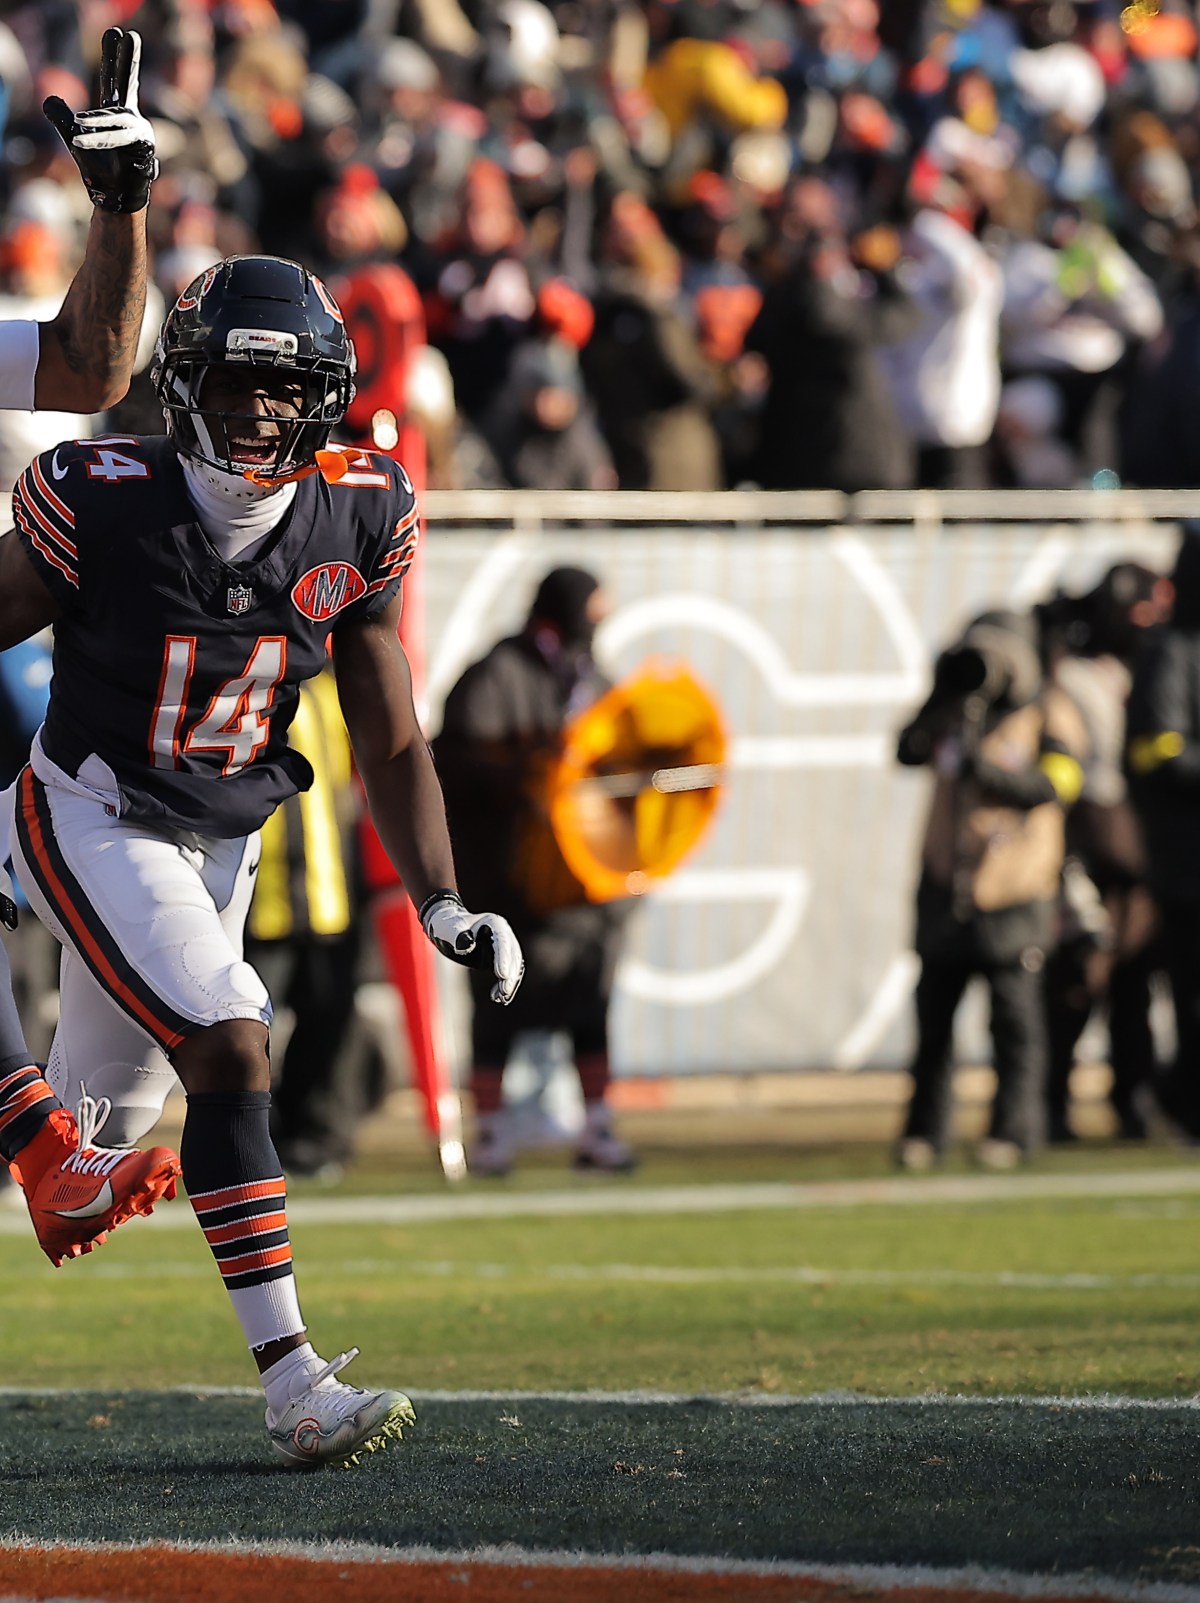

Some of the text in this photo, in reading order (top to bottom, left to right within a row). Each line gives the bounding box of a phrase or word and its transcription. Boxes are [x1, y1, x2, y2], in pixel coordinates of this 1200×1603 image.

[248, 335, 277, 343] BEARS
[72, 436, 152, 484] 14
[147, 634, 288, 779] 14
